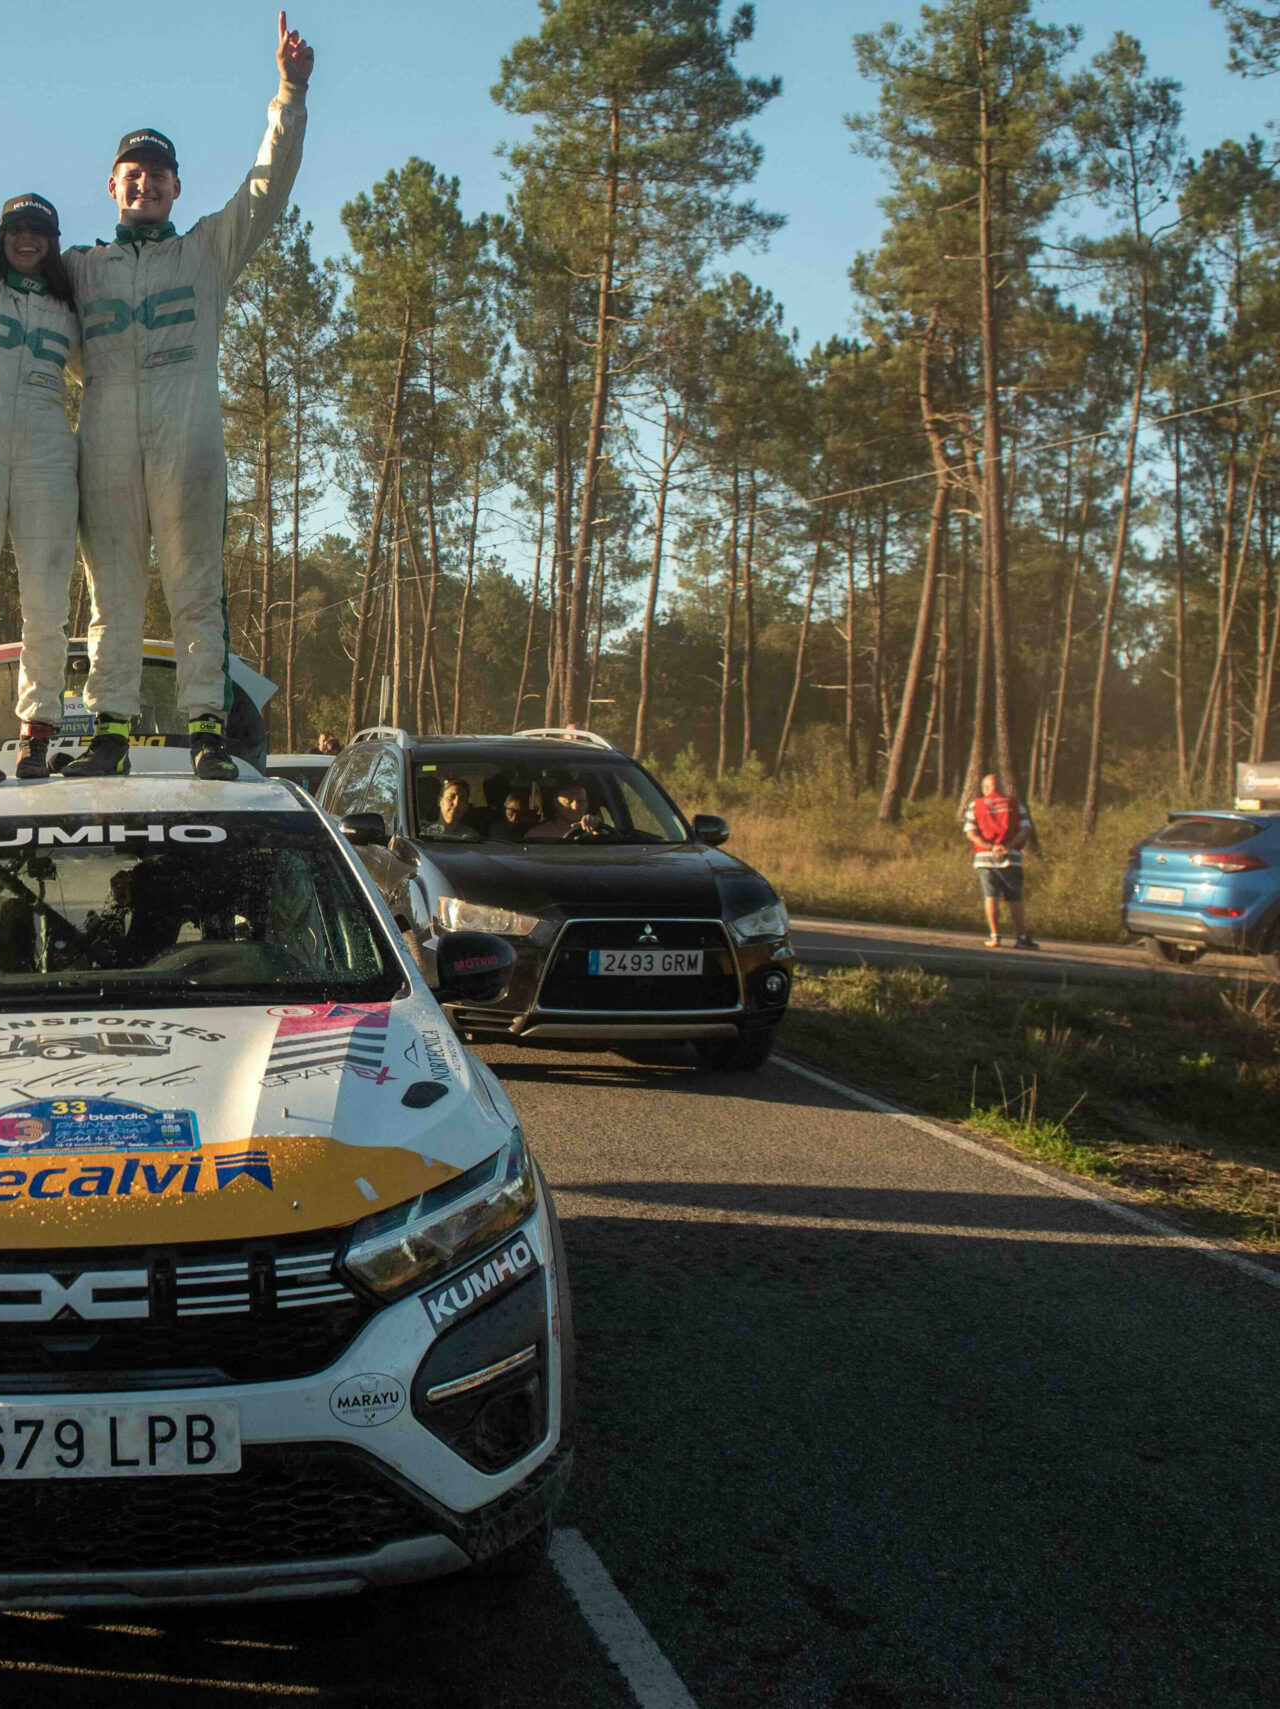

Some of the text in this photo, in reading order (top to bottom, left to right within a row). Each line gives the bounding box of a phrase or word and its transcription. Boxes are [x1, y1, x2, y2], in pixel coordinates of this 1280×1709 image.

[129, 135, 168, 149] KUMHO
[13, 201, 51, 215] KUMHO
[454, 954, 498, 971] MOTRIO
[604, 953, 654, 973] 2493
[662, 953, 699, 973] GRM
[52, 1101, 87, 1115] 33
[89, 1112, 148, 1121] blendio
[55, 1119, 150, 1130] PRINCESA
[73, 1126, 150, 1137] ASTURIAS
[428, 1240, 531, 1324] KUMHO
[337, 1390, 399, 1409] MARAYU
[109, 1413, 218, 1467] LPB
